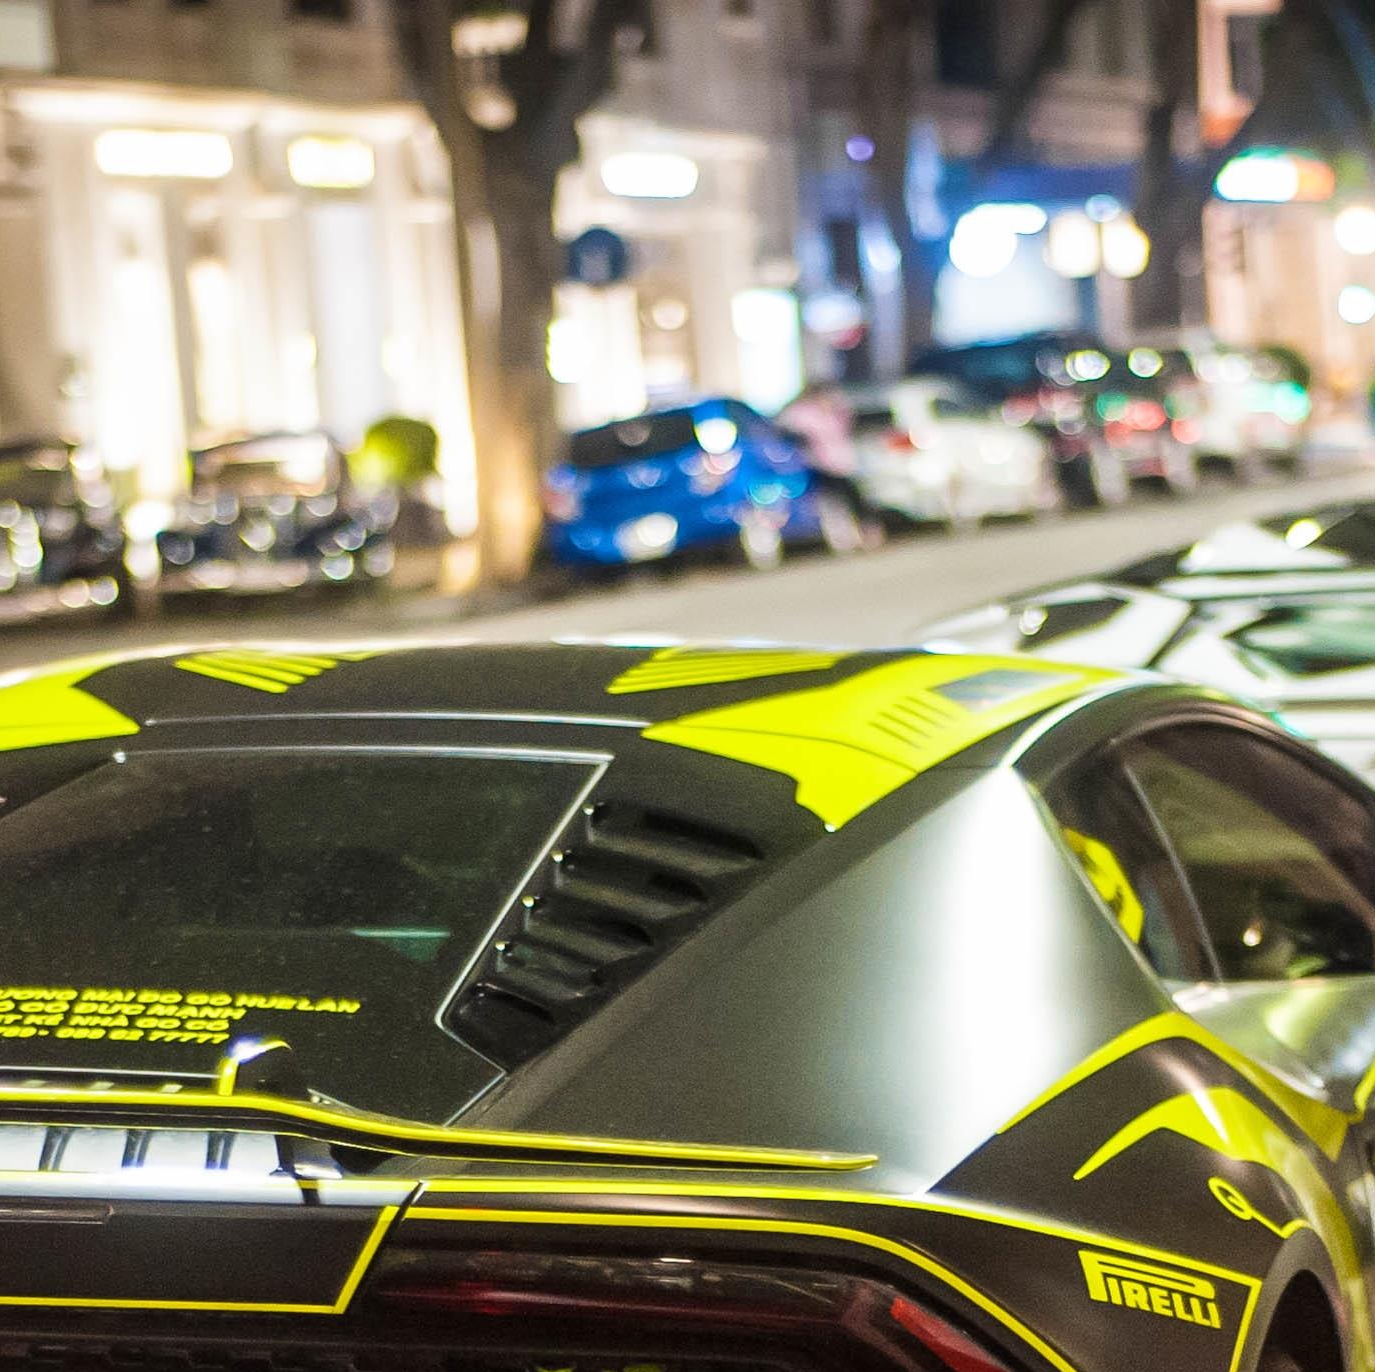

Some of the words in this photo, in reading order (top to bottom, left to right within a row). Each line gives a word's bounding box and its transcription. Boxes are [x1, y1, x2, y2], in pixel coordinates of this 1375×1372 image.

[297, 998, 360, 1013] LAN
[149, 1030, 229, 1044] 77777
[1078, 1249, 1222, 1330] PIRELLI
